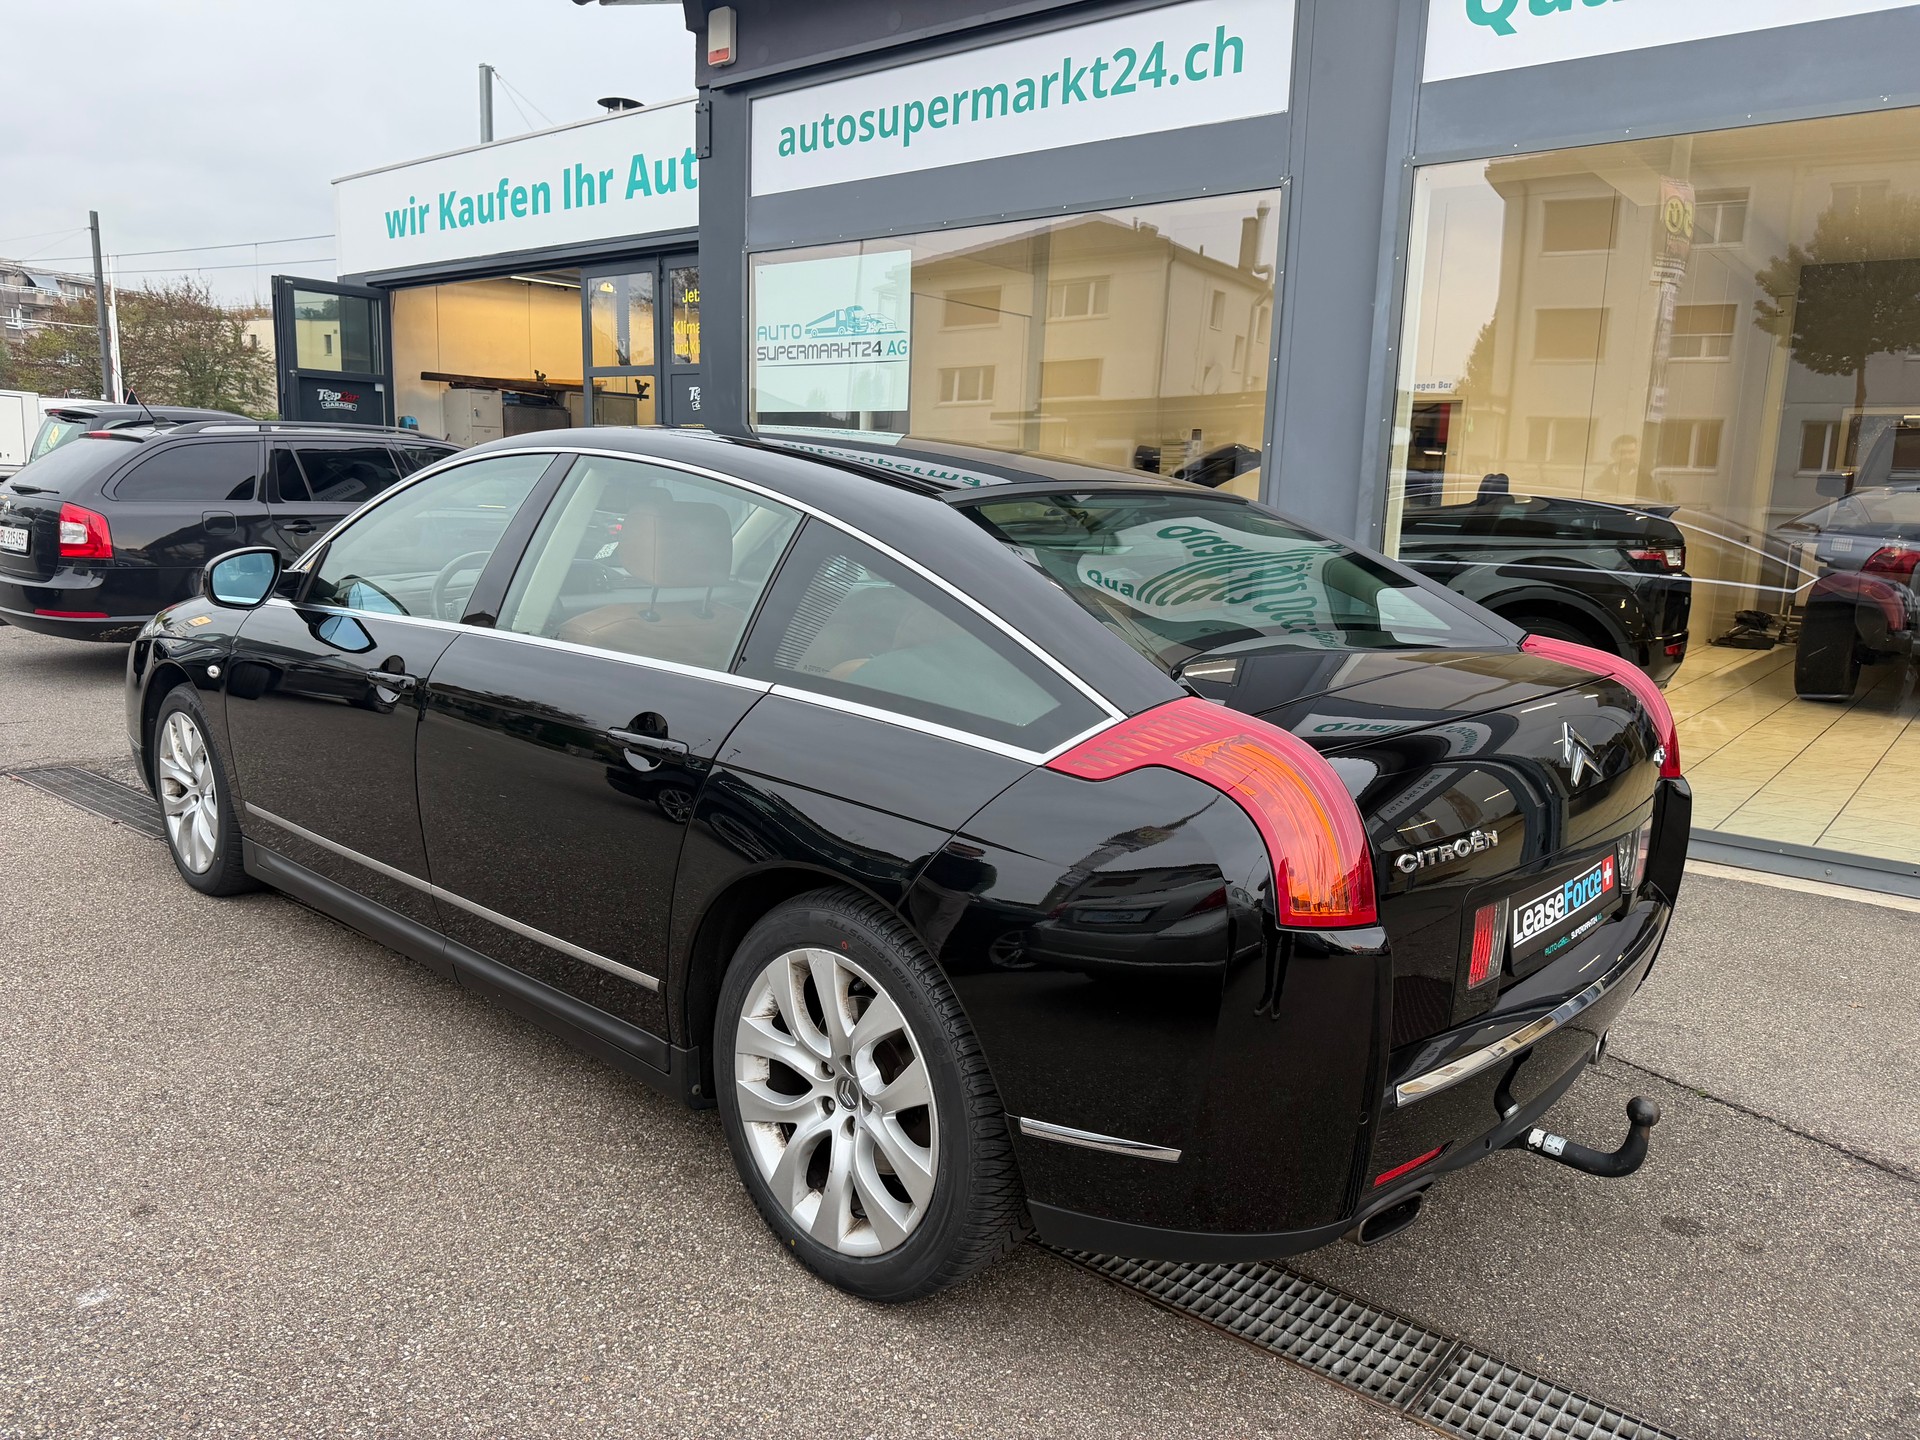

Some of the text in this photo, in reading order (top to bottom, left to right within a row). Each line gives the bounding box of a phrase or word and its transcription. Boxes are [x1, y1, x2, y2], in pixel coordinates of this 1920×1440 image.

[777, 25, 1244, 157] autosupermarkt24.ch
[385, 147, 698, 239] wir Kaufen Ihr Aut
[682, 288, 700, 302] Jet
[757, 324, 802, 341] AUTO
[757, 340, 908, 361] SUPERMARKT24 AG
[1438, 381, 1453, 389] Bar
[1394, 830, 1498, 873] CITROËN
[1513, 869, 1602, 944] LeaseForce
[824, 918, 847, 933] ALL
[847, 928, 893, 967] Season
[892, 965, 918, 1000] Elite
